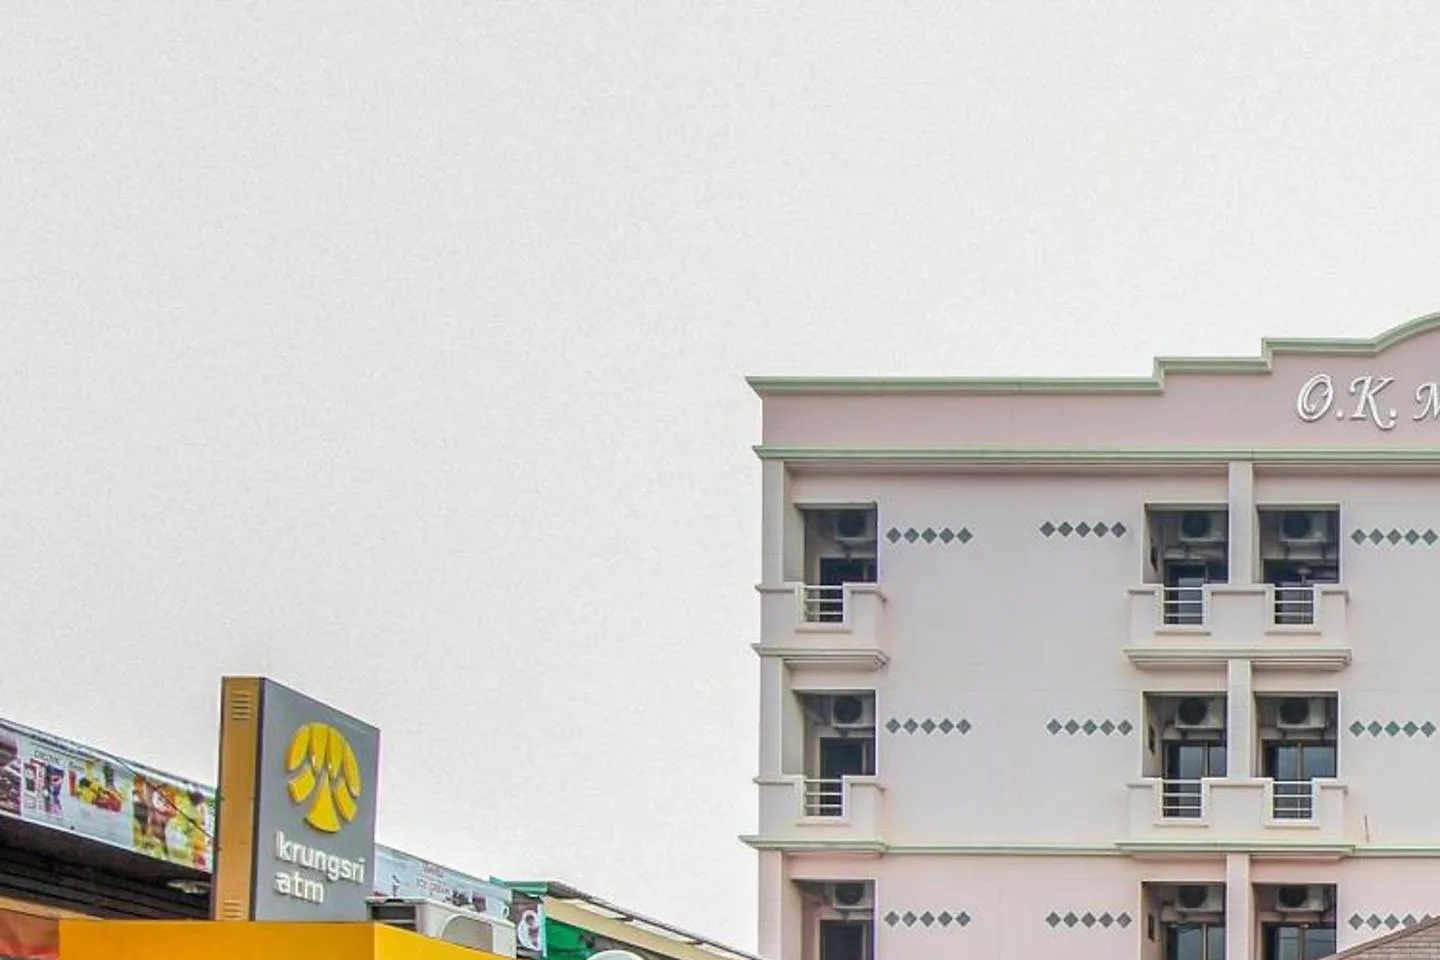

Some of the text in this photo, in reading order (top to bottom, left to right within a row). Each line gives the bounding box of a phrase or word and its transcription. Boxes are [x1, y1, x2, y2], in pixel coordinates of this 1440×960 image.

[1296, 373, 1399, 431] O.K.
[275, 831, 366, 884] krungsri
[274, 871, 325, 904] atm
